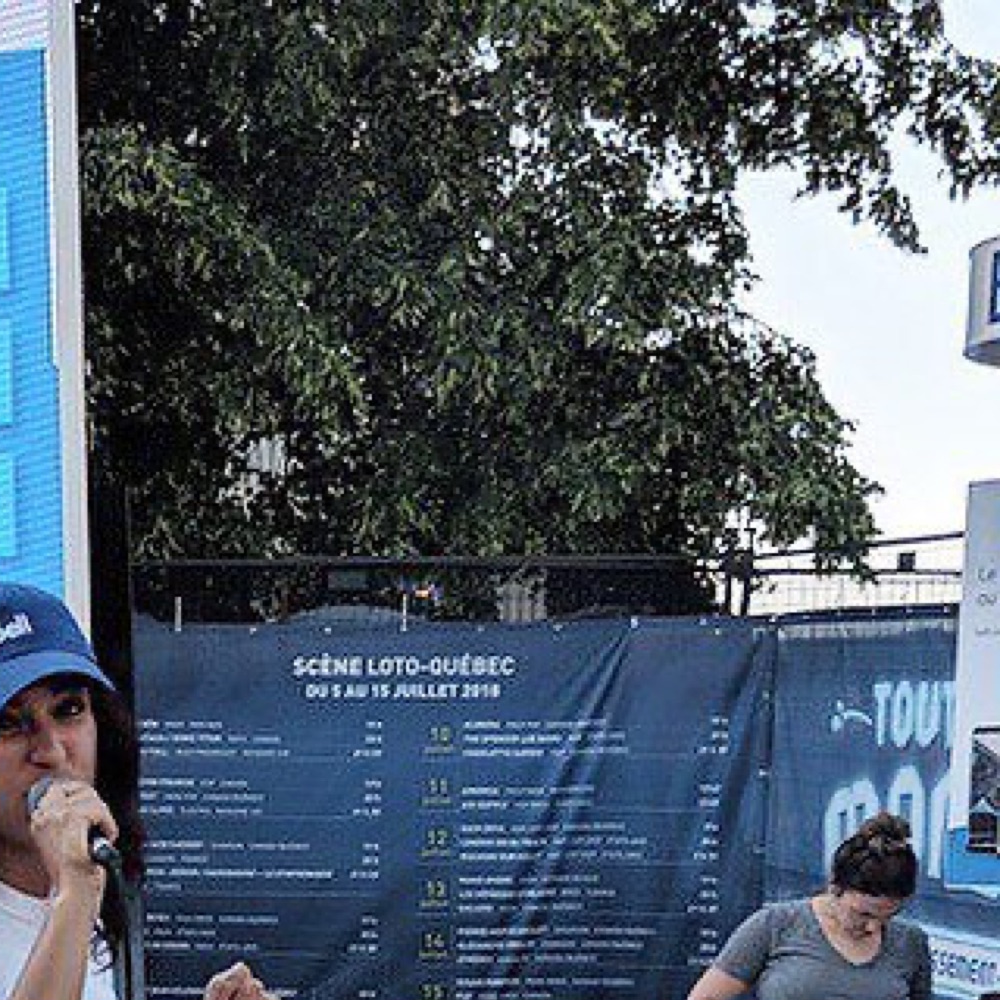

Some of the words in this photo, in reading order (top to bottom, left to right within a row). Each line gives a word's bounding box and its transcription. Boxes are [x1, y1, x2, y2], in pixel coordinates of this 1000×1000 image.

[293, 653, 363, 677] SCÈNE
[305, 684, 328, 698] DU
[344, 684, 369, 698] AU
[393, 684, 459, 698] JUILLET
